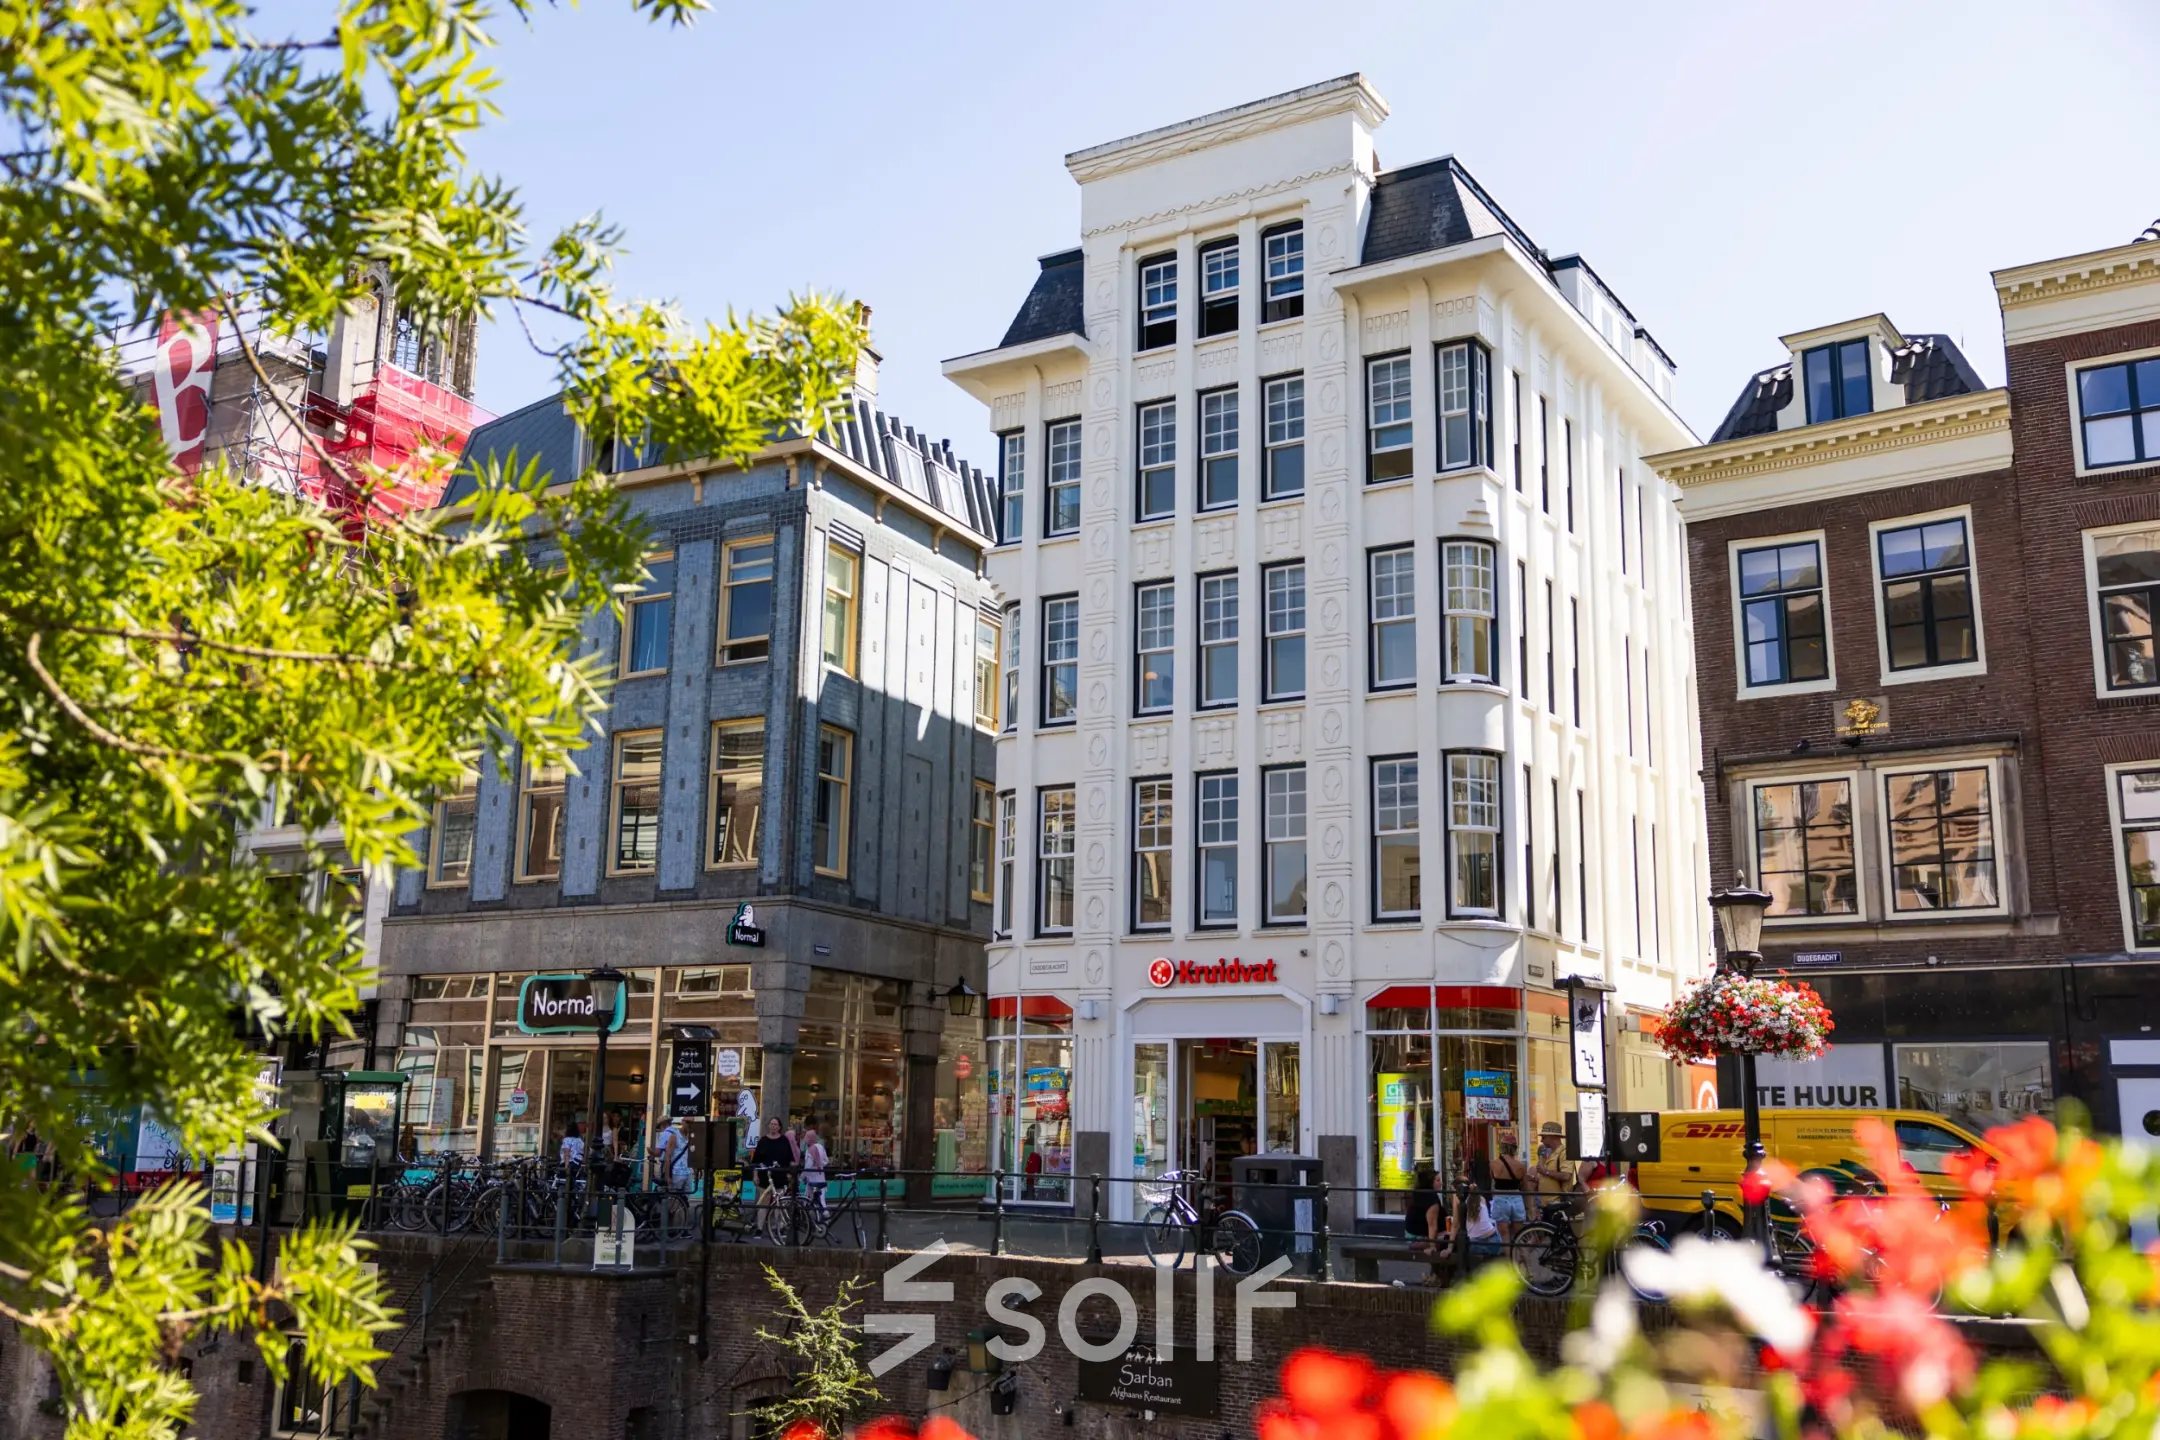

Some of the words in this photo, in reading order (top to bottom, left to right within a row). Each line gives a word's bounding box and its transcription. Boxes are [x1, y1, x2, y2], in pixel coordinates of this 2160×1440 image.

[735, 929, 759, 943] Normal
[1797, 954, 1838, 962] OUDEGRACHT
[1179, 958, 1277, 984] Kruidvat
[533, 987, 595, 1017] Norma
[678, 1058, 702, 1070] Sarban
[1757, 1086, 1786, 1106] TE
[1794, 1086, 1879, 1107] HUUR
[678, 1104, 698, 1114] ingang
[1118, 1364, 1173, 1388] Sarban
[1110, 1386, 1143, 1400] Afghaans
[1143, 1390, 1182, 1405] Restaurant
